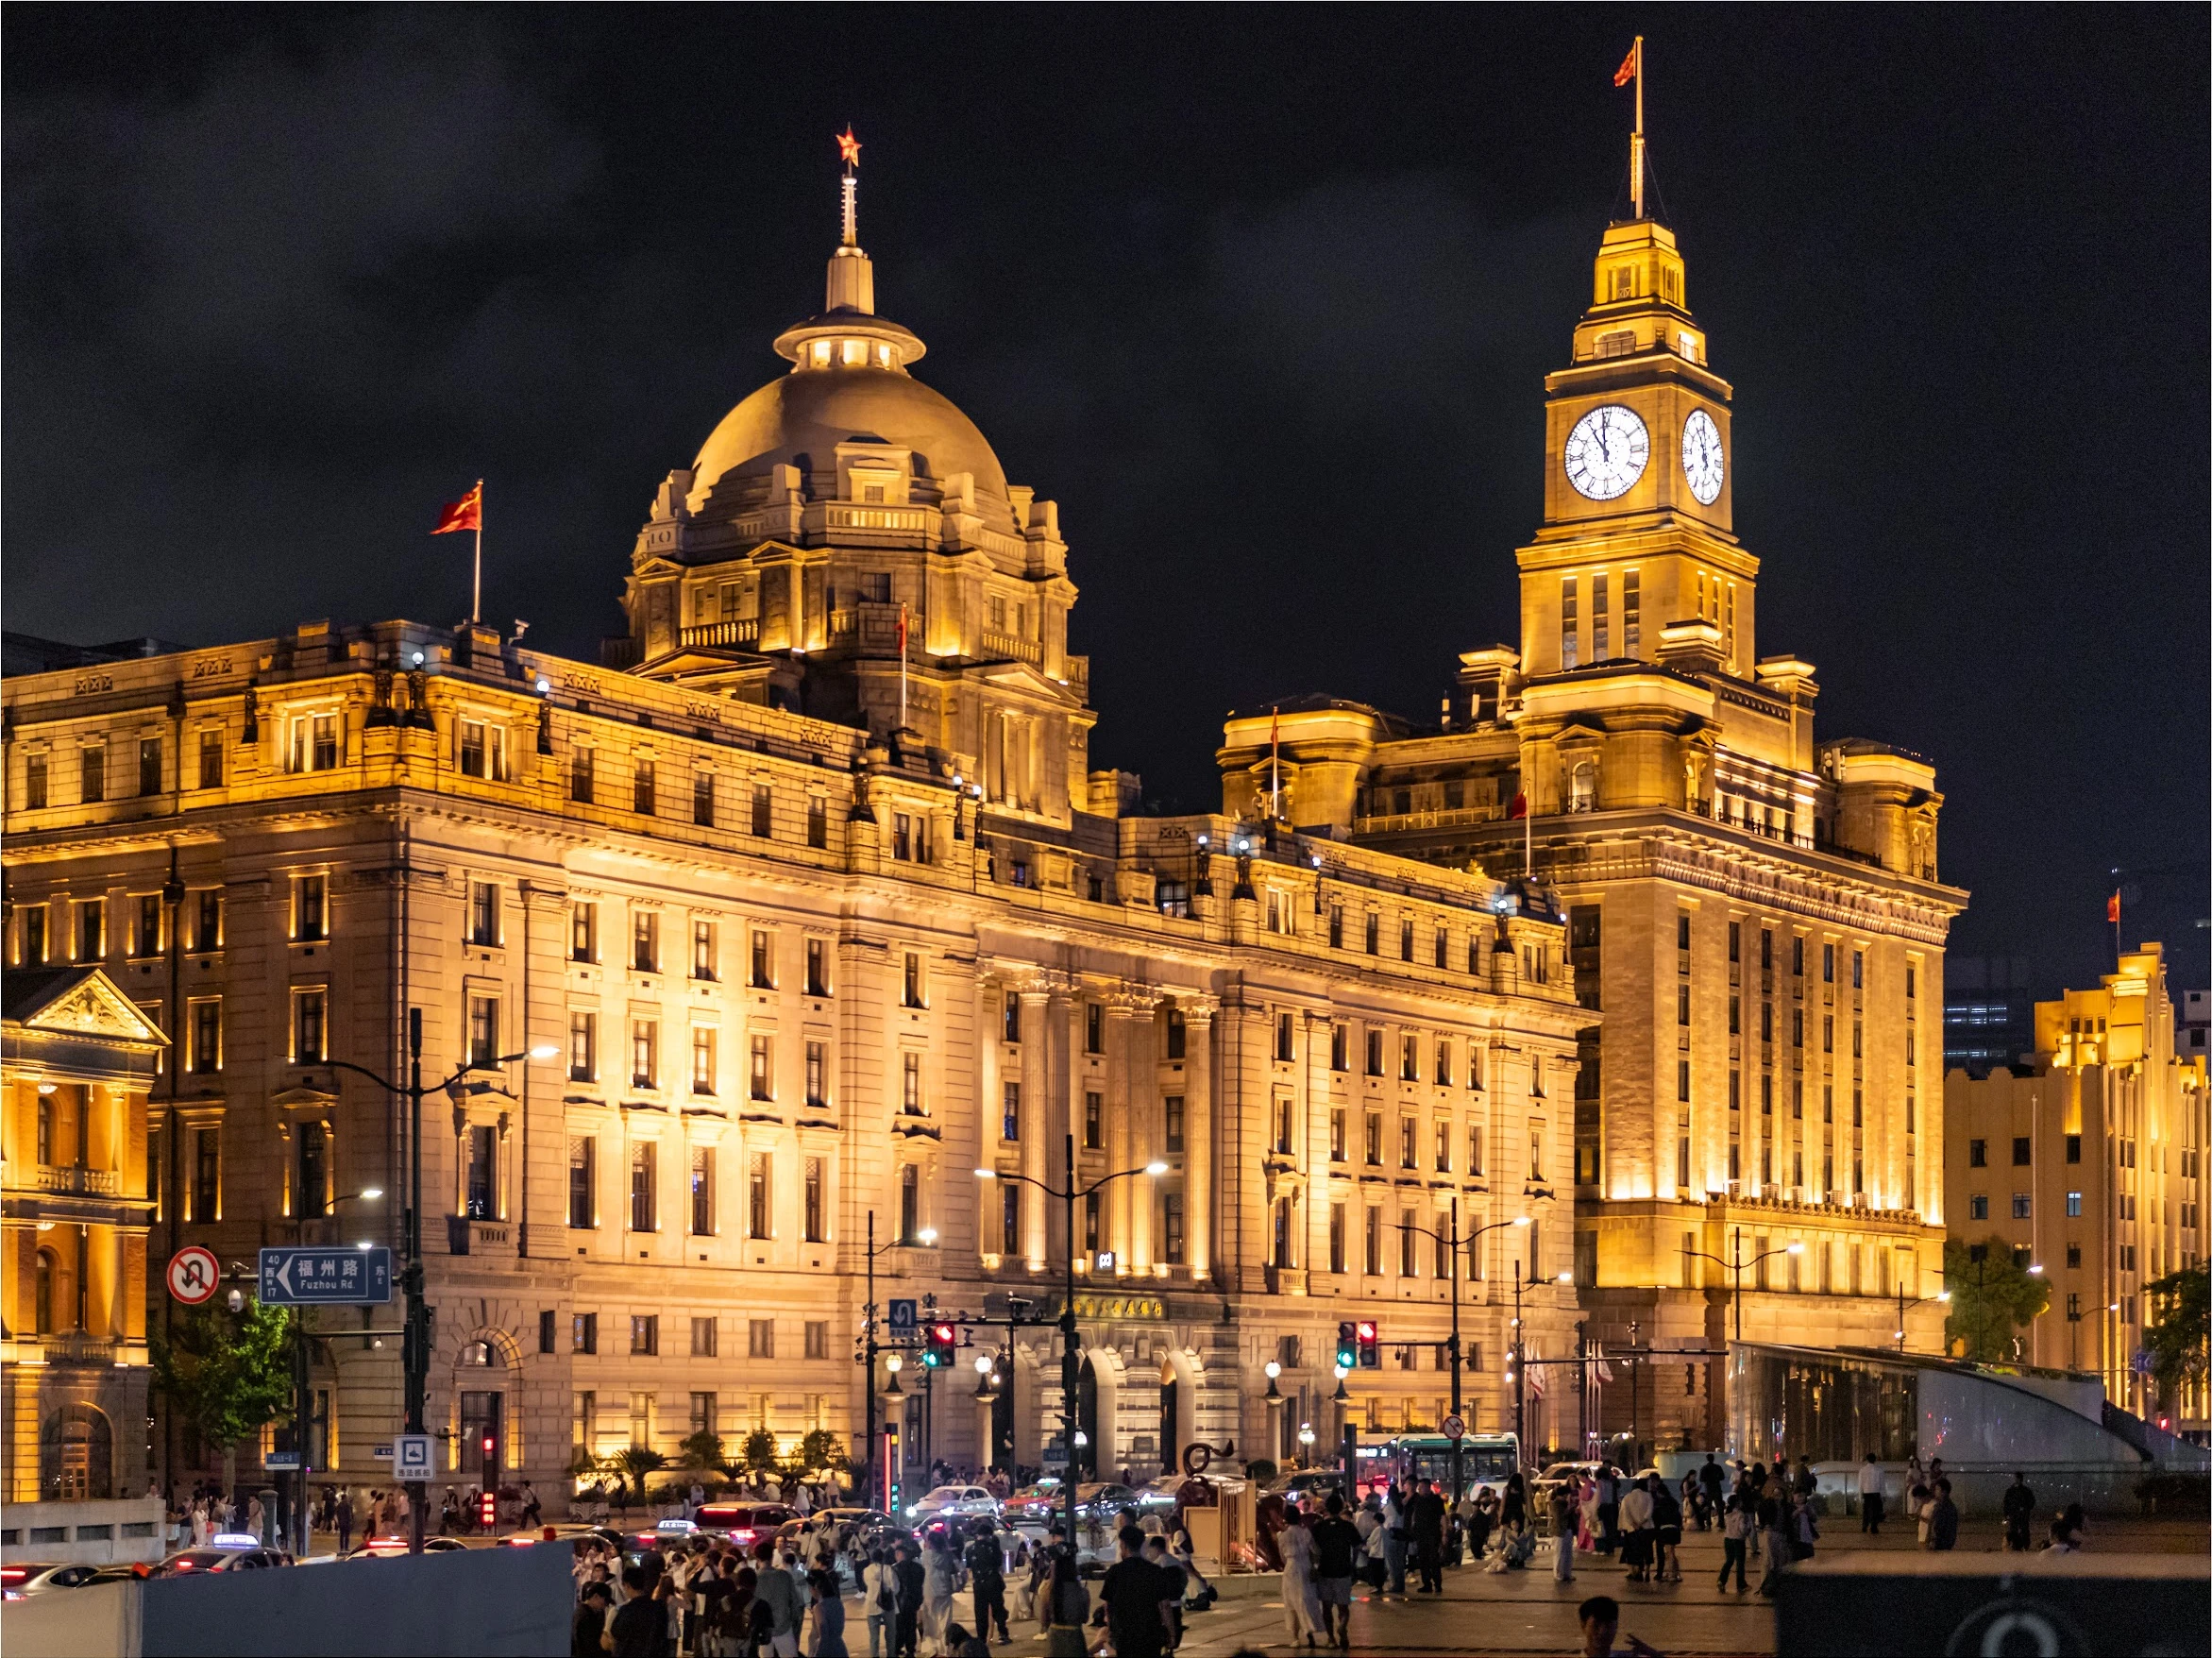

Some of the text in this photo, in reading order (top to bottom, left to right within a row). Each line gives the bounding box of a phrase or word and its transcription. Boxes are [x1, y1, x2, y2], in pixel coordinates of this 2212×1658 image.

[268, 1256, 279, 1264] 40
[265, 1267, 275, 1277] 西
[297, 1259, 358, 1277] 福州路
[376, 1265, 385, 1276] 东
[300, 1279, 355, 1289] Fuzhou Rd.
[267, 1288, 277, 1296] 17
